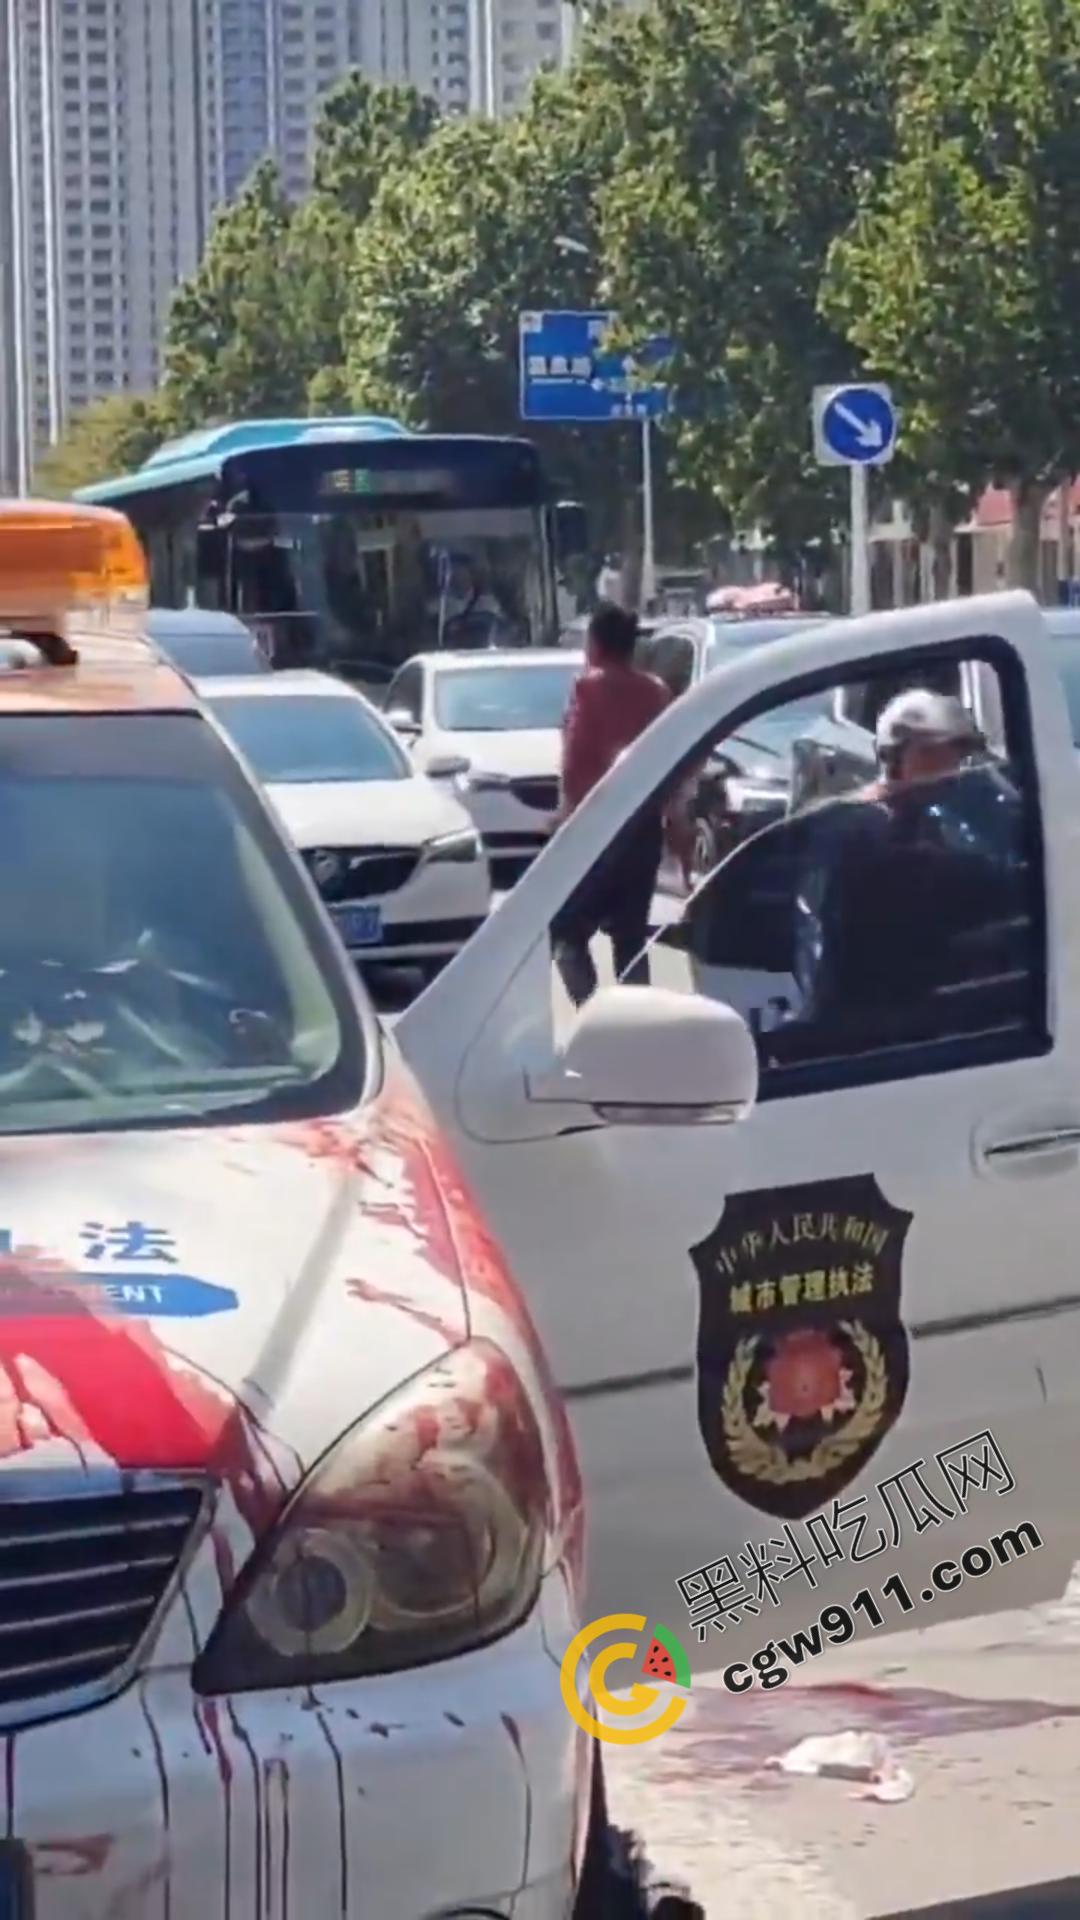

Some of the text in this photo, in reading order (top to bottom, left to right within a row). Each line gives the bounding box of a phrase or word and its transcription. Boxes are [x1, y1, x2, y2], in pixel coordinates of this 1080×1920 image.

[730, 1262, 874, 1313] 城市管理执法
